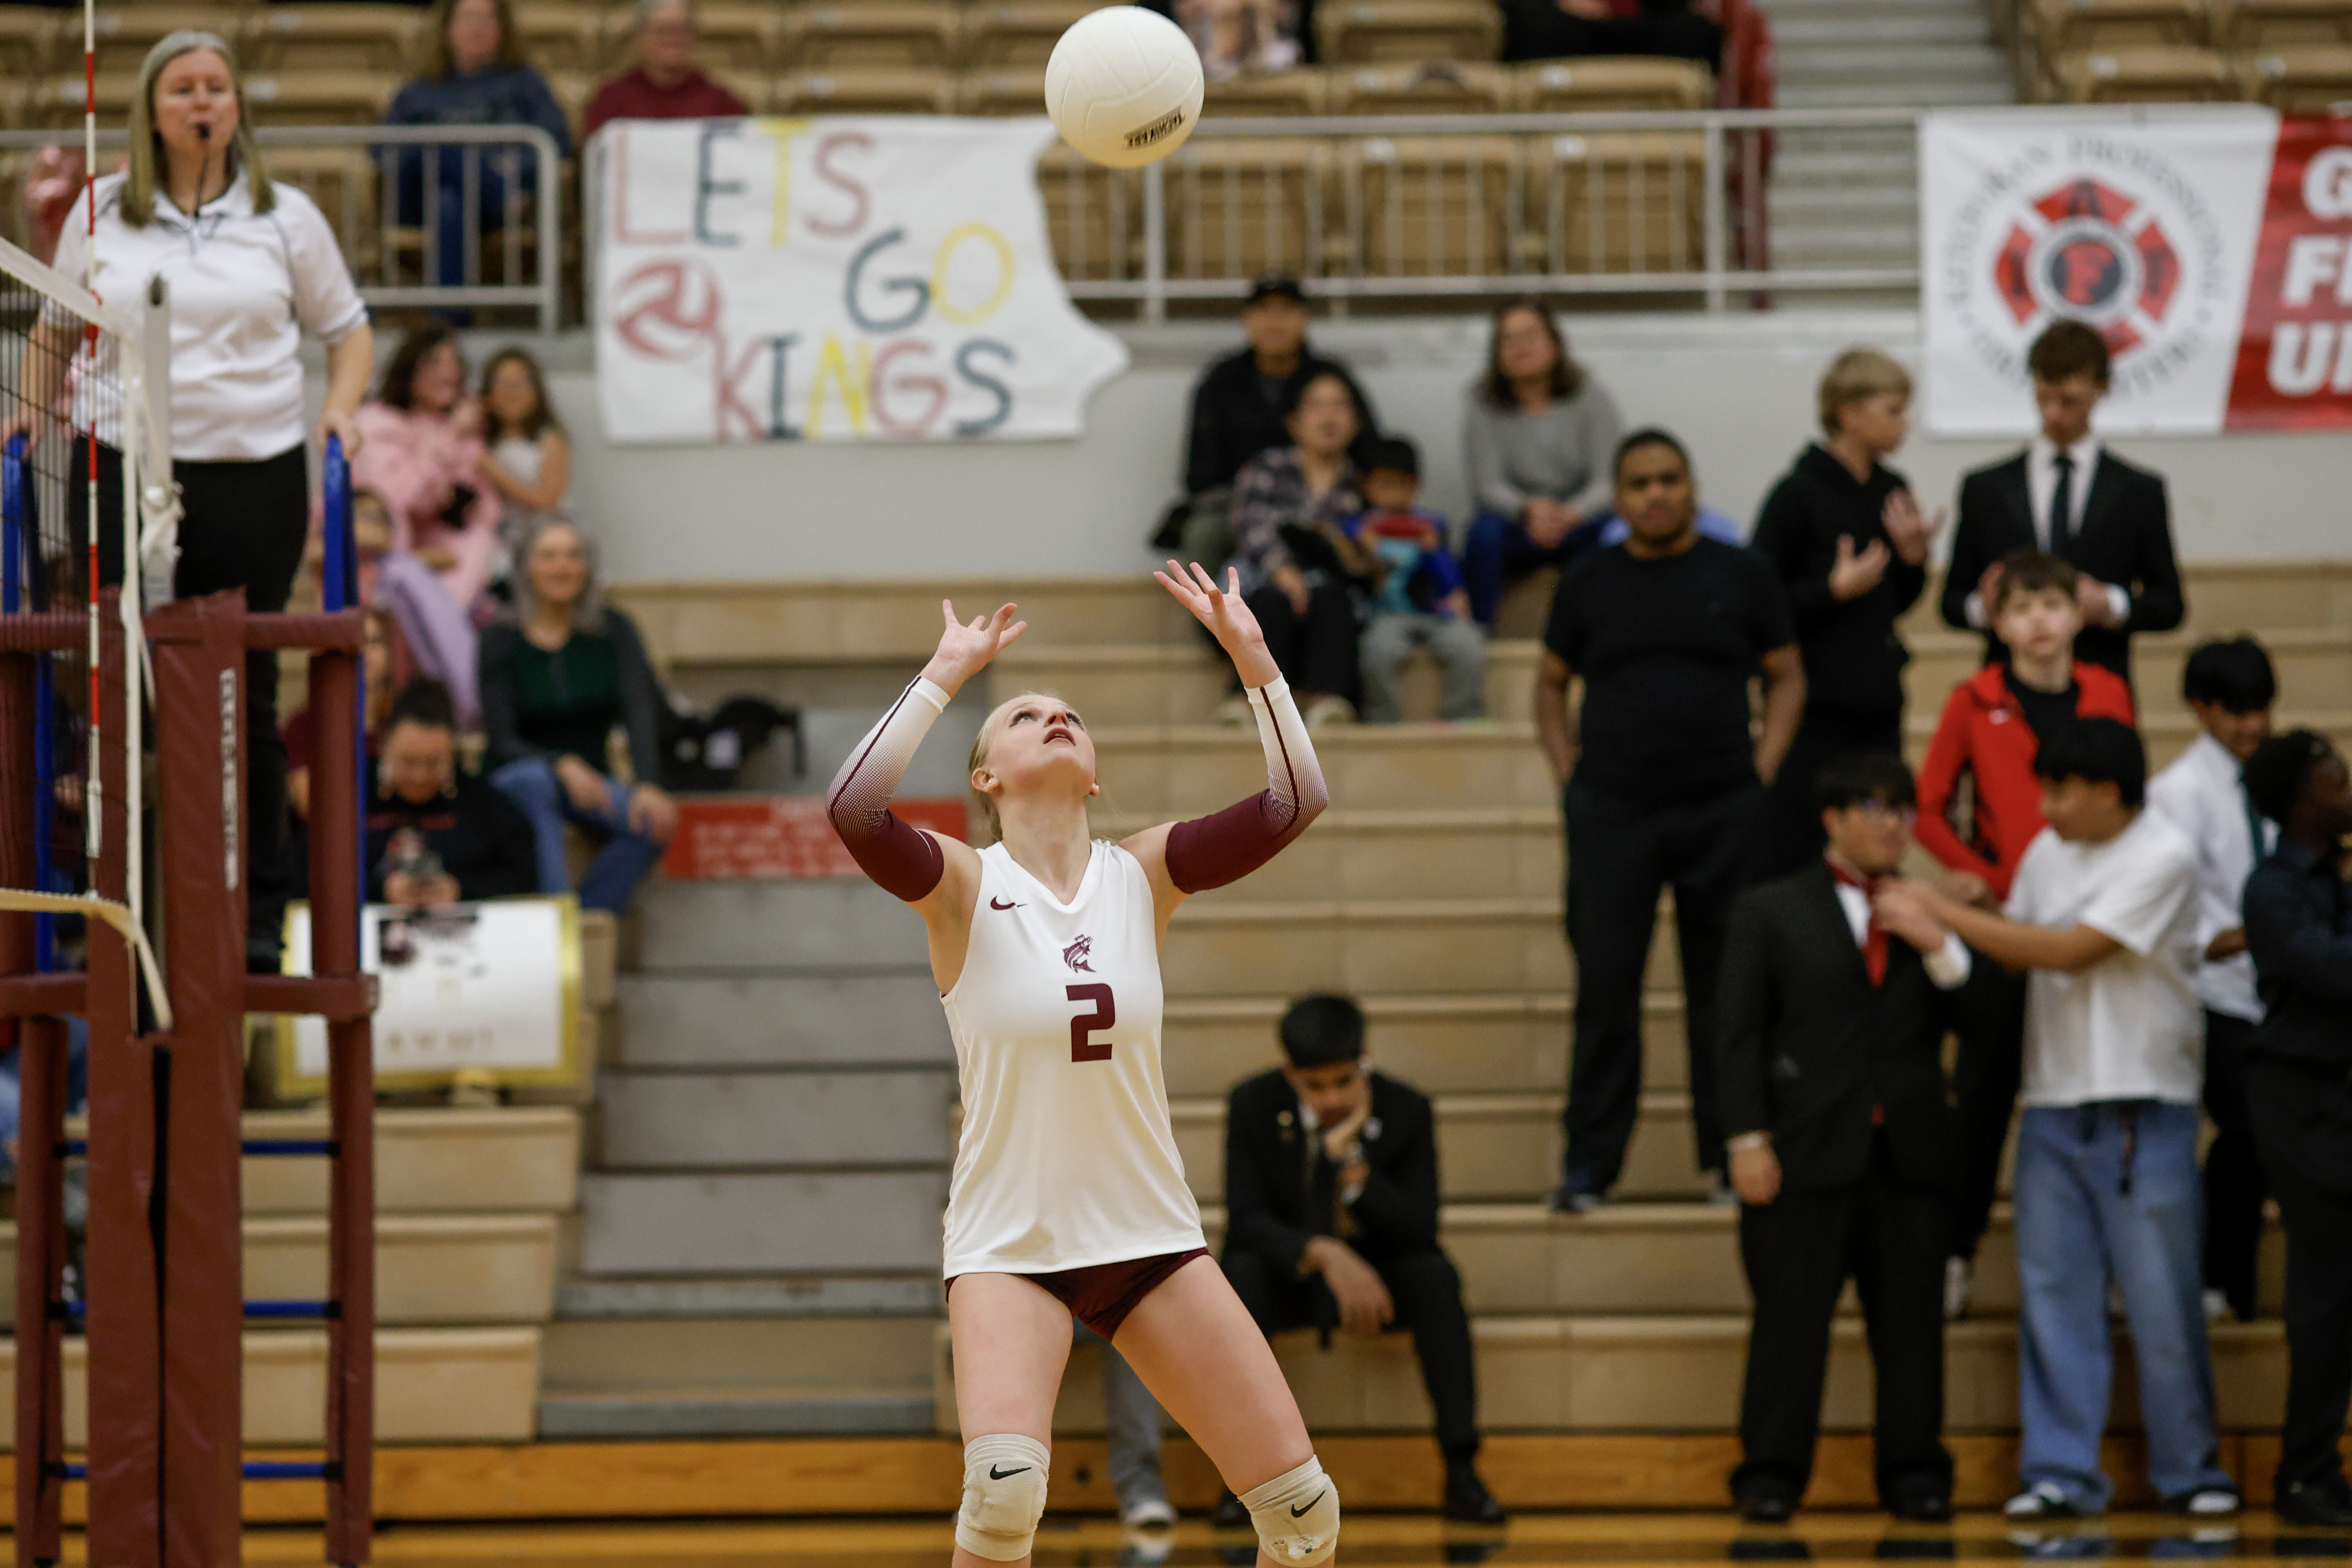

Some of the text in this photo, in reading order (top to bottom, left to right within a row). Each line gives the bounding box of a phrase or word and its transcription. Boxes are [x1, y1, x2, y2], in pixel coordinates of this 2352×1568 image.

[610, 117, 874, 248] LETS
[844, 220, 1017, 334] GO
[713, 331, 1018, 443] KINGS
[1065, 983, 1116, 1062] 2
